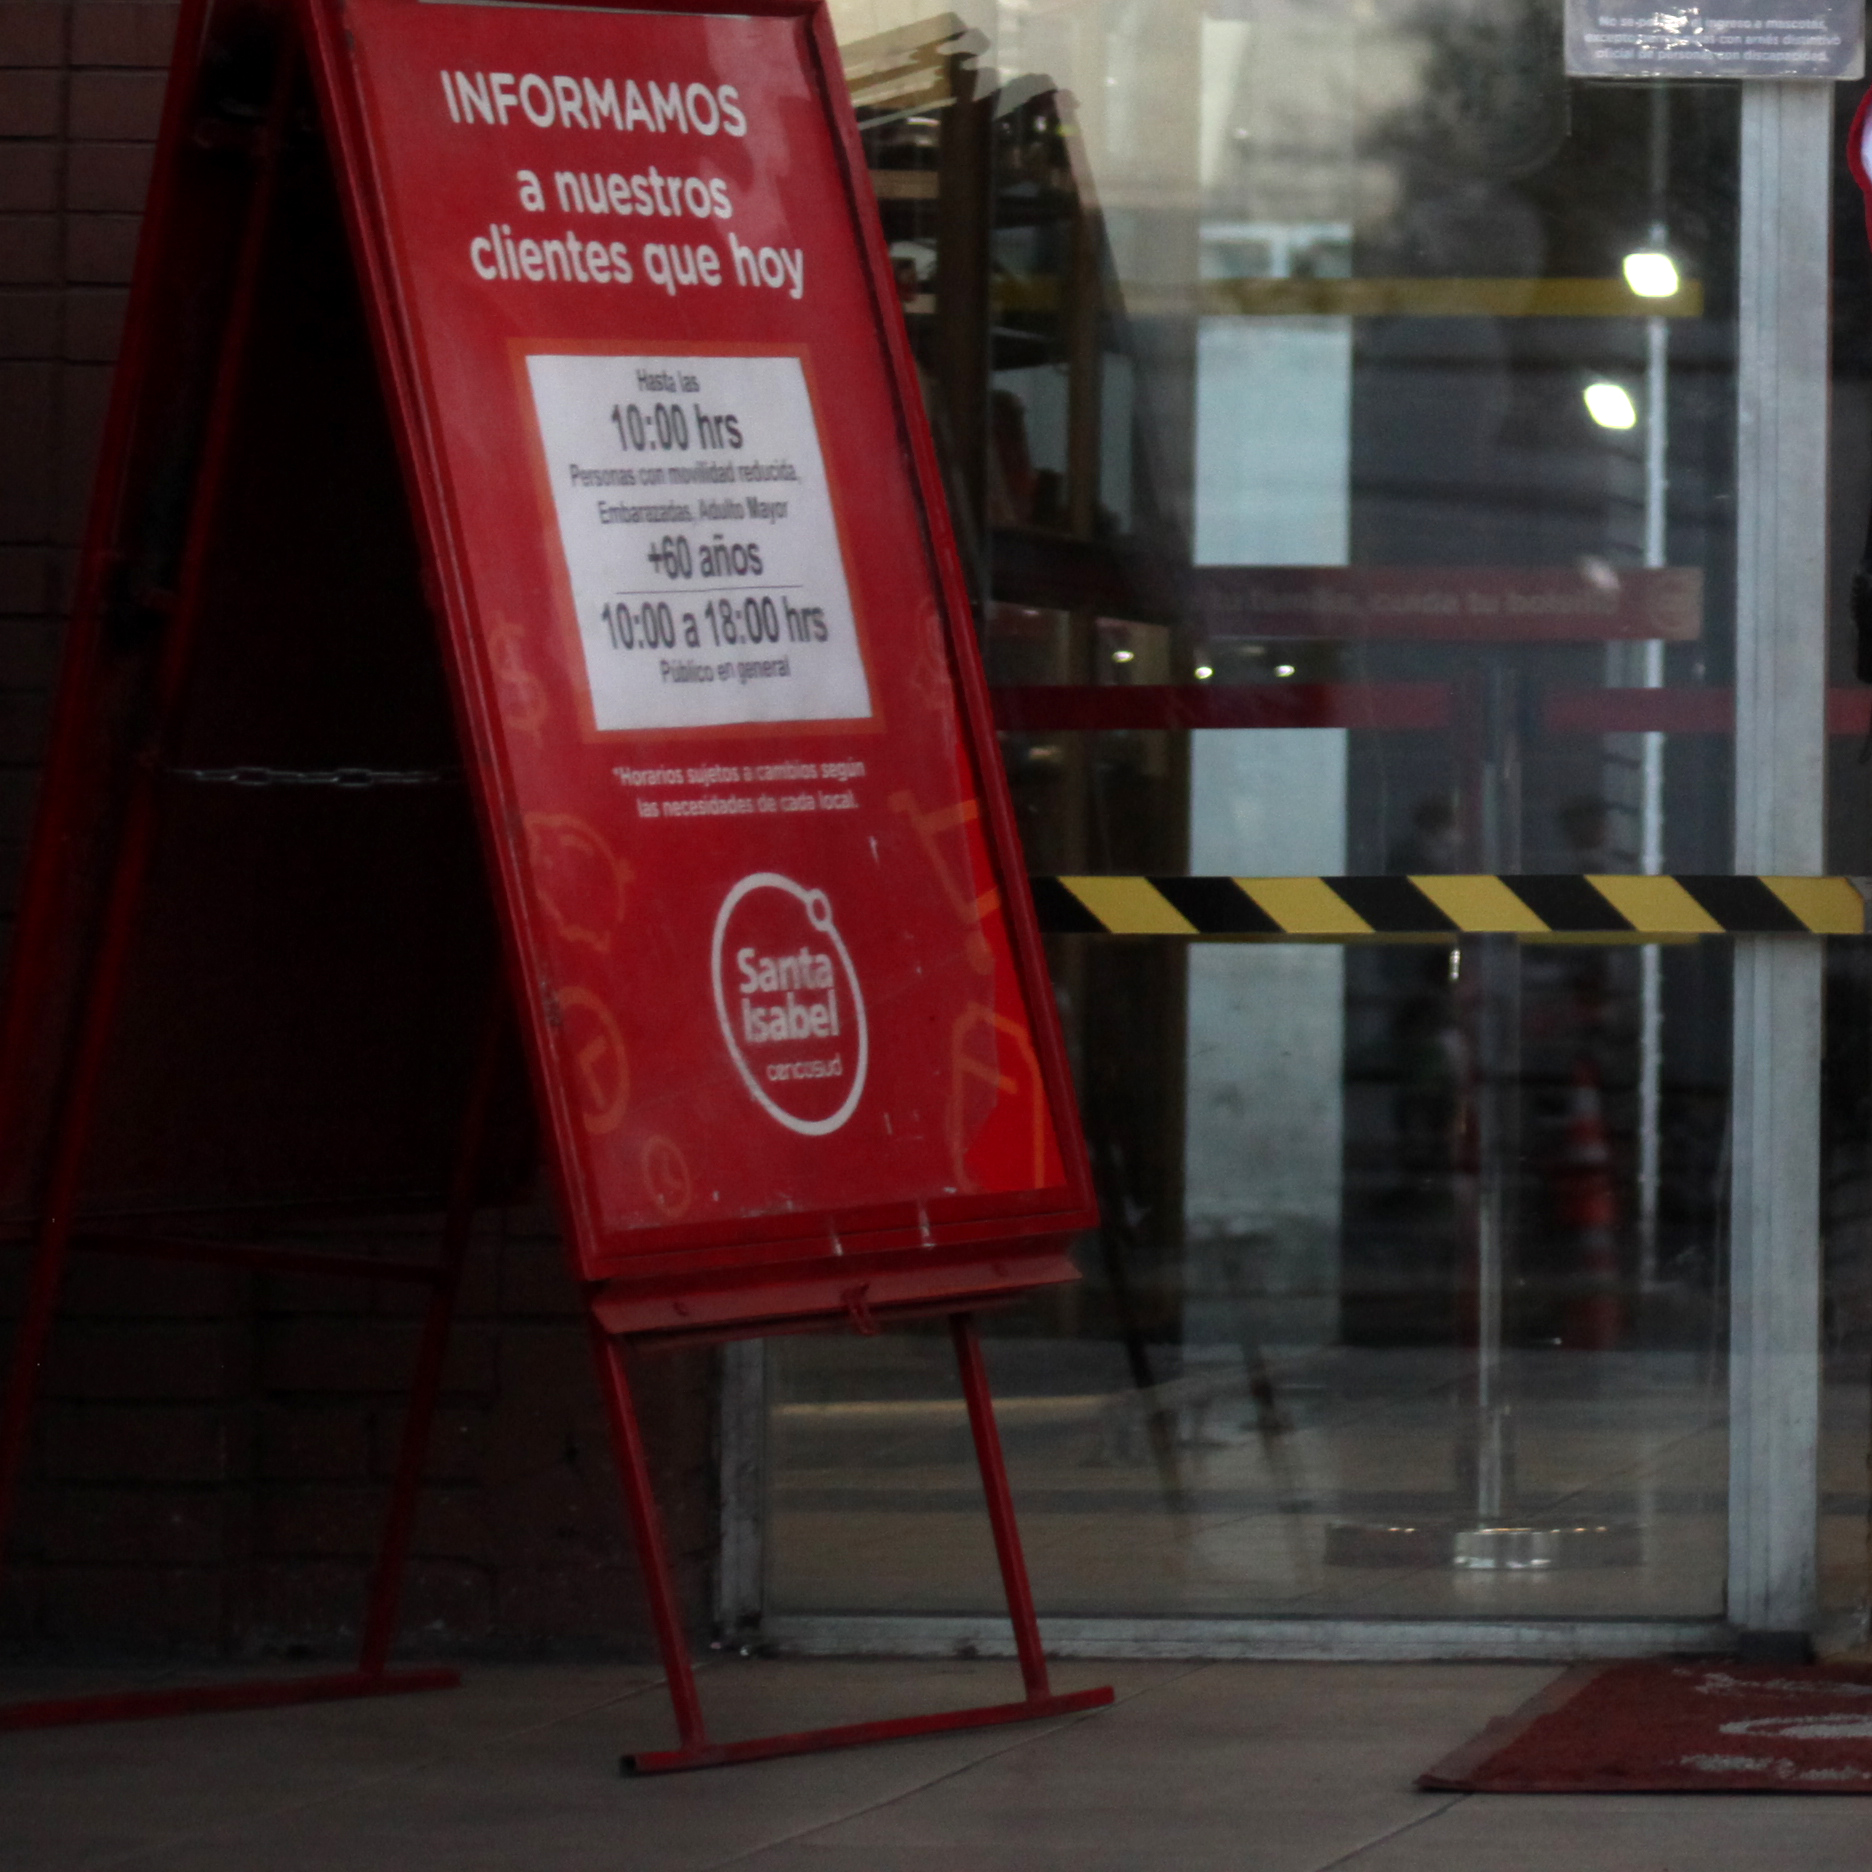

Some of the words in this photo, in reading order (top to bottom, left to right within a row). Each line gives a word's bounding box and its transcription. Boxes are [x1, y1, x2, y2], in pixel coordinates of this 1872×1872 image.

[439, 69, 747, 137] INFORMAMOS
[516, 169, 546, 213] a
[554, 166, 733, 219] nuestros
[469, 224, 635, 285] clientes
[643, 241, 722, 297] que
[728, 232, 804, 300] hoy
[637, 369, 676, 393] Hasta
[611, 403, 690, 452] 10:00
[697, 404, 744, 450] hrs
[570, 463, 636, 488] Personas
[700, 498, 746, 522] Adulto
[747, 496, 788, 525] Mayor
[647, 535, 692, 580] +60
[698, 533, 764, 577] años
[601, 601, 676, 650] 10:00
[681, 611, 700, 648] a
[704, 596, 780, 646] 18:00
[783, 596, 828, 643] hrs
[660, 657, 714, 683] Público
[737, 656, 791, 686] general
[736, 947, 834, 993] Santa
[740, 989, 840, 1044] Isabel
